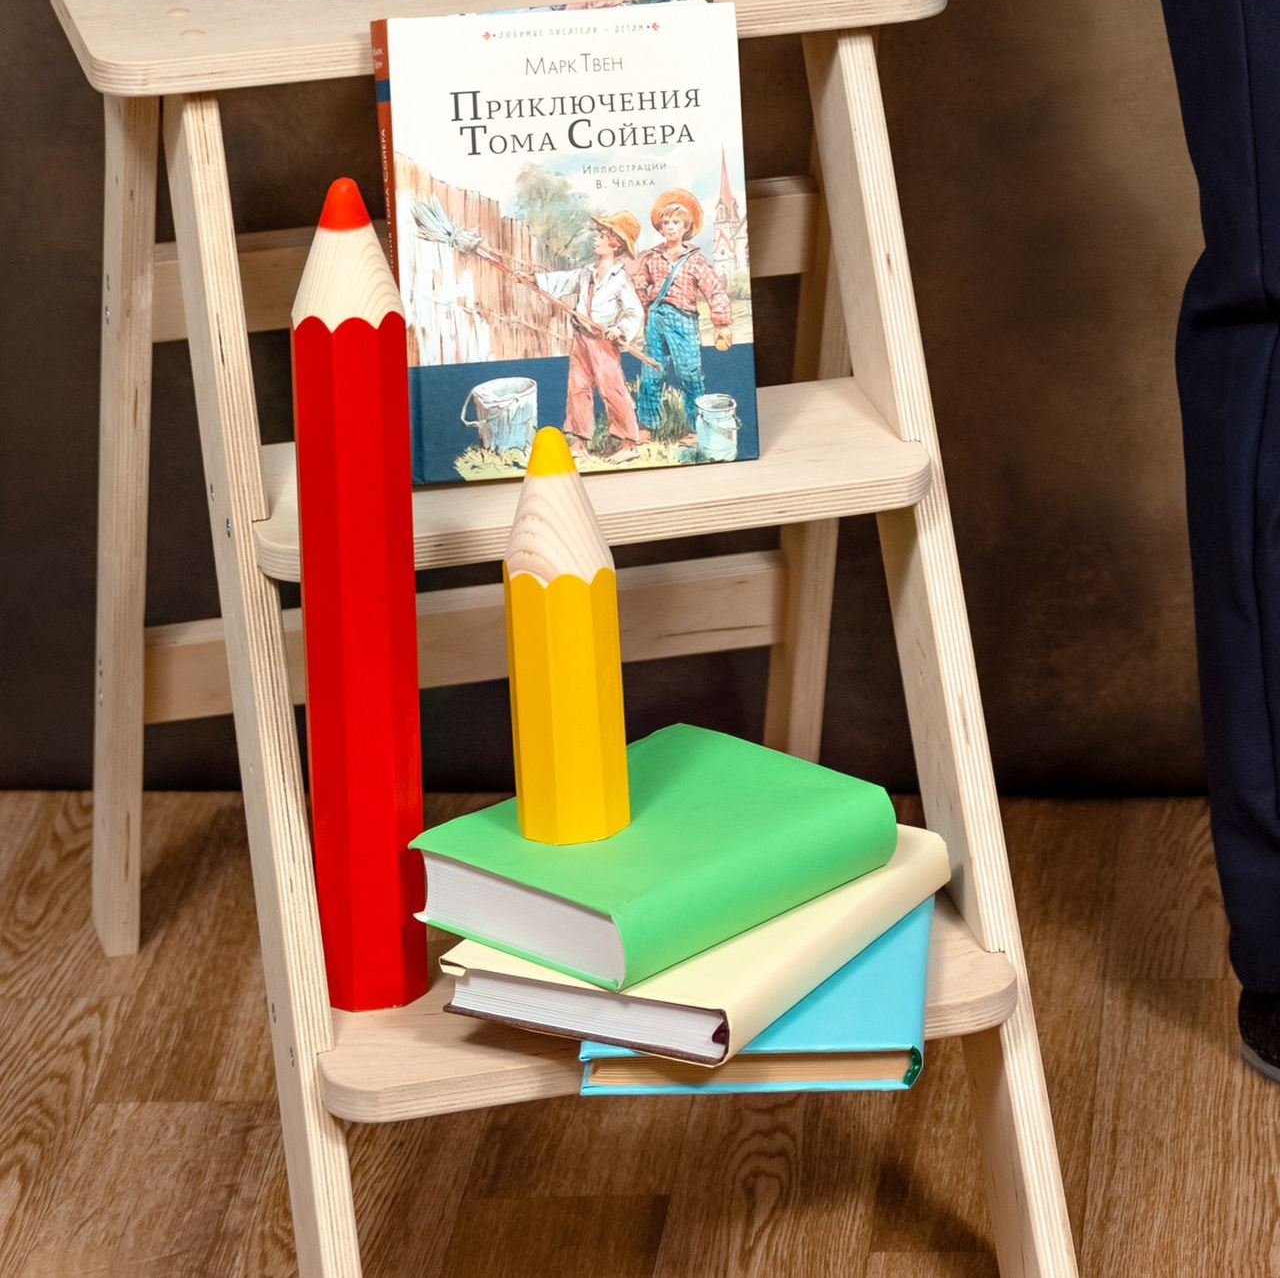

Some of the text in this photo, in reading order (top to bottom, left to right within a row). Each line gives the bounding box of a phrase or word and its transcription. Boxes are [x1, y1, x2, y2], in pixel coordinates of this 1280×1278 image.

[498, 24, 644, 39] ЛЮБИМЫЕ ПИСАТЕЛИ ДЕТЯМ
[450, 88, 702, 122] ПРИКЛЮЧЕНИЯ
[459, 118, 696, 156] ТОМА СОЙЕРА
